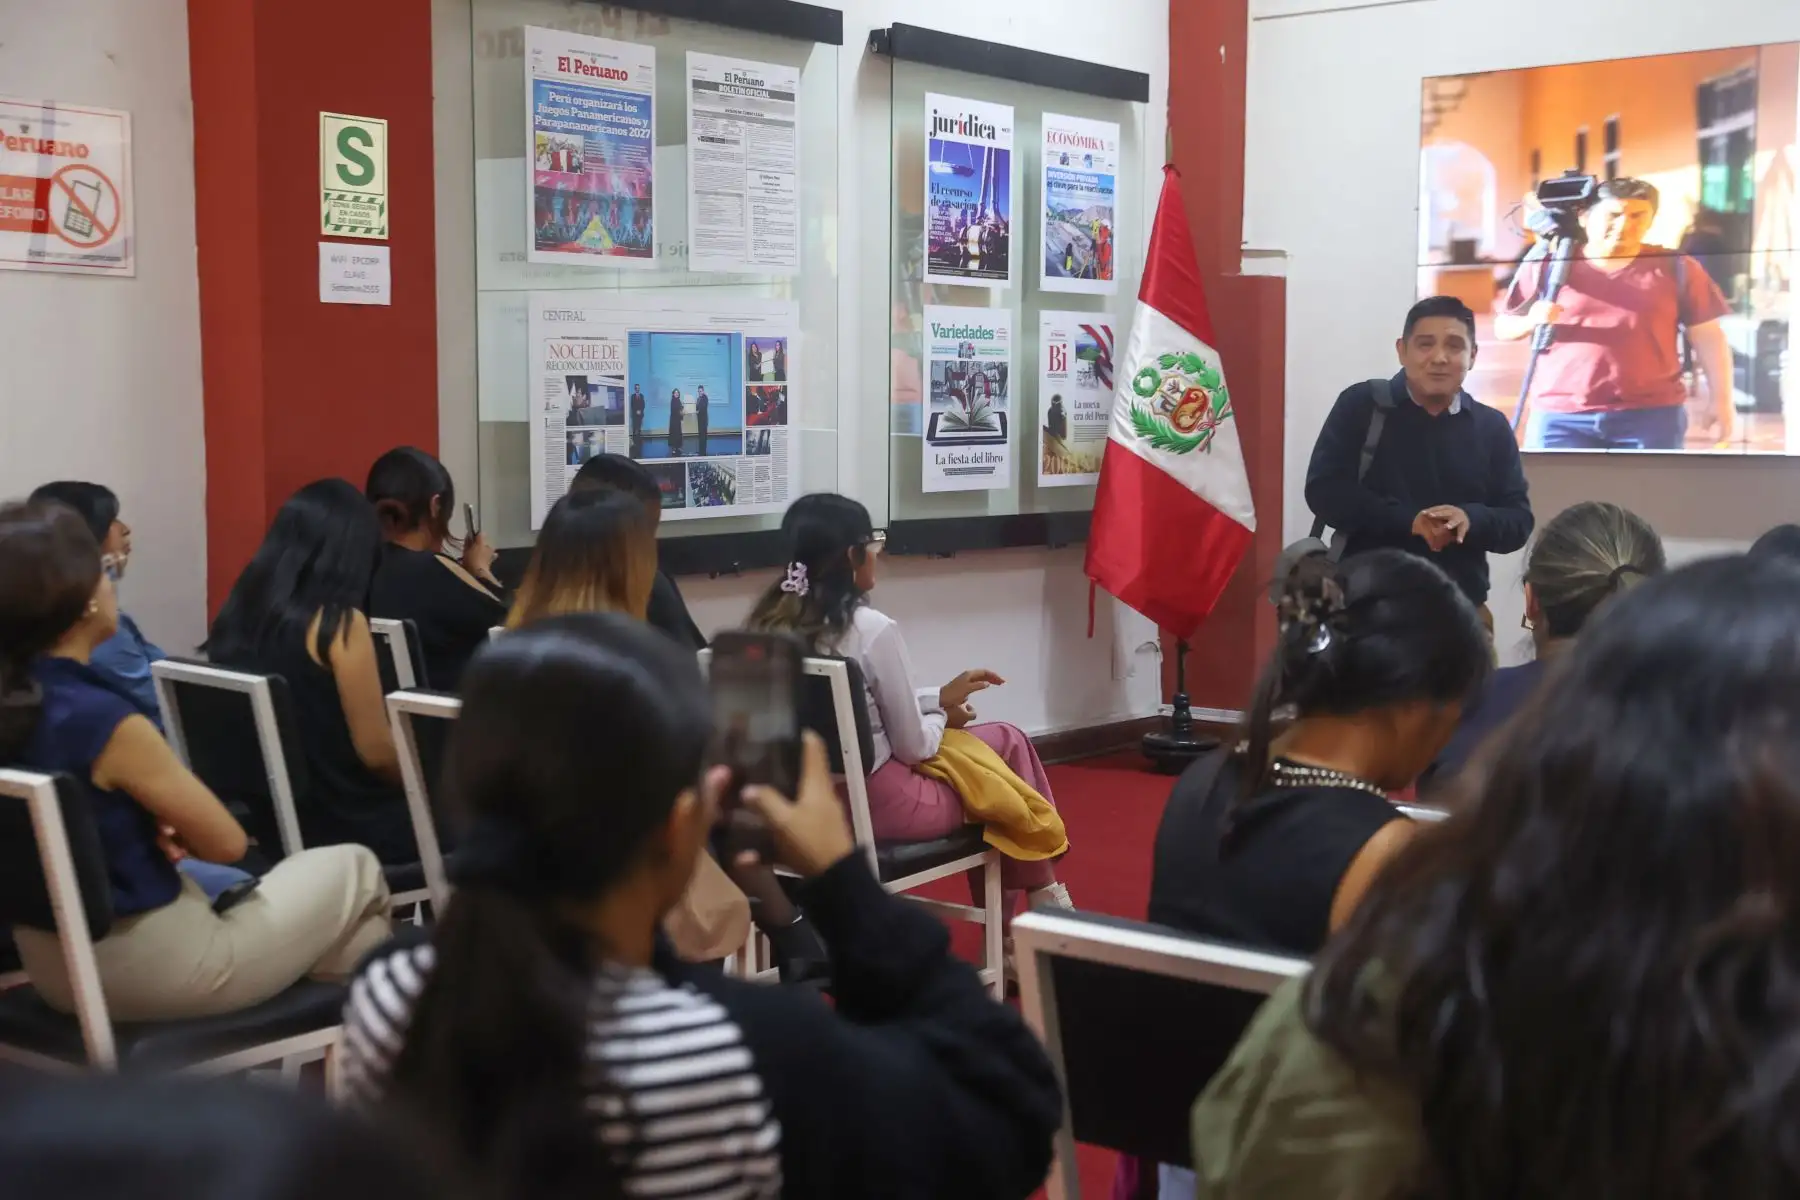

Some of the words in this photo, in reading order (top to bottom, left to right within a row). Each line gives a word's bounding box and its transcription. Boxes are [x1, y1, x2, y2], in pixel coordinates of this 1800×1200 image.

[558, 56, 571, 73] El
[574, 58, 629, 82] Peruano
[724, 72, 732, 82] El
[733, 73, 765, 87] Peruano
[549, 91, 573, 104] Perú
[573, 96, 623, 111] organizará
[624, 102, 638, 113] los
[537, 103, 570, 117] Juegos
[571, 106, 642, 126] Panamericanos
[642, 117, 649, 128] y
[929, 108, 996, 141] jurídica
[535, 115, 628, 136] Parapanamericanos
[629, 126, 651, 139] 2027
[0, 129, 89, 158] eruano
[336, 126, 376, 187] S
[542, 310, 586, 322] CENTRAL
[931, 322, 994, 340] Variedades
[549, 344, 601, 360] NOCHE
[602, 344, 620, 360] DE
[1048, 343, 1067, 372] Bi
[546, 360, 623, 372] RECONOCIMIENTO
[1074, 400, 1082, 409] La
[935, 453, 946, 465] La
[948, 452, 970, 465] fiesta
[971, 452, 983, 464] del
[985, 451, 1004, 464] libro
